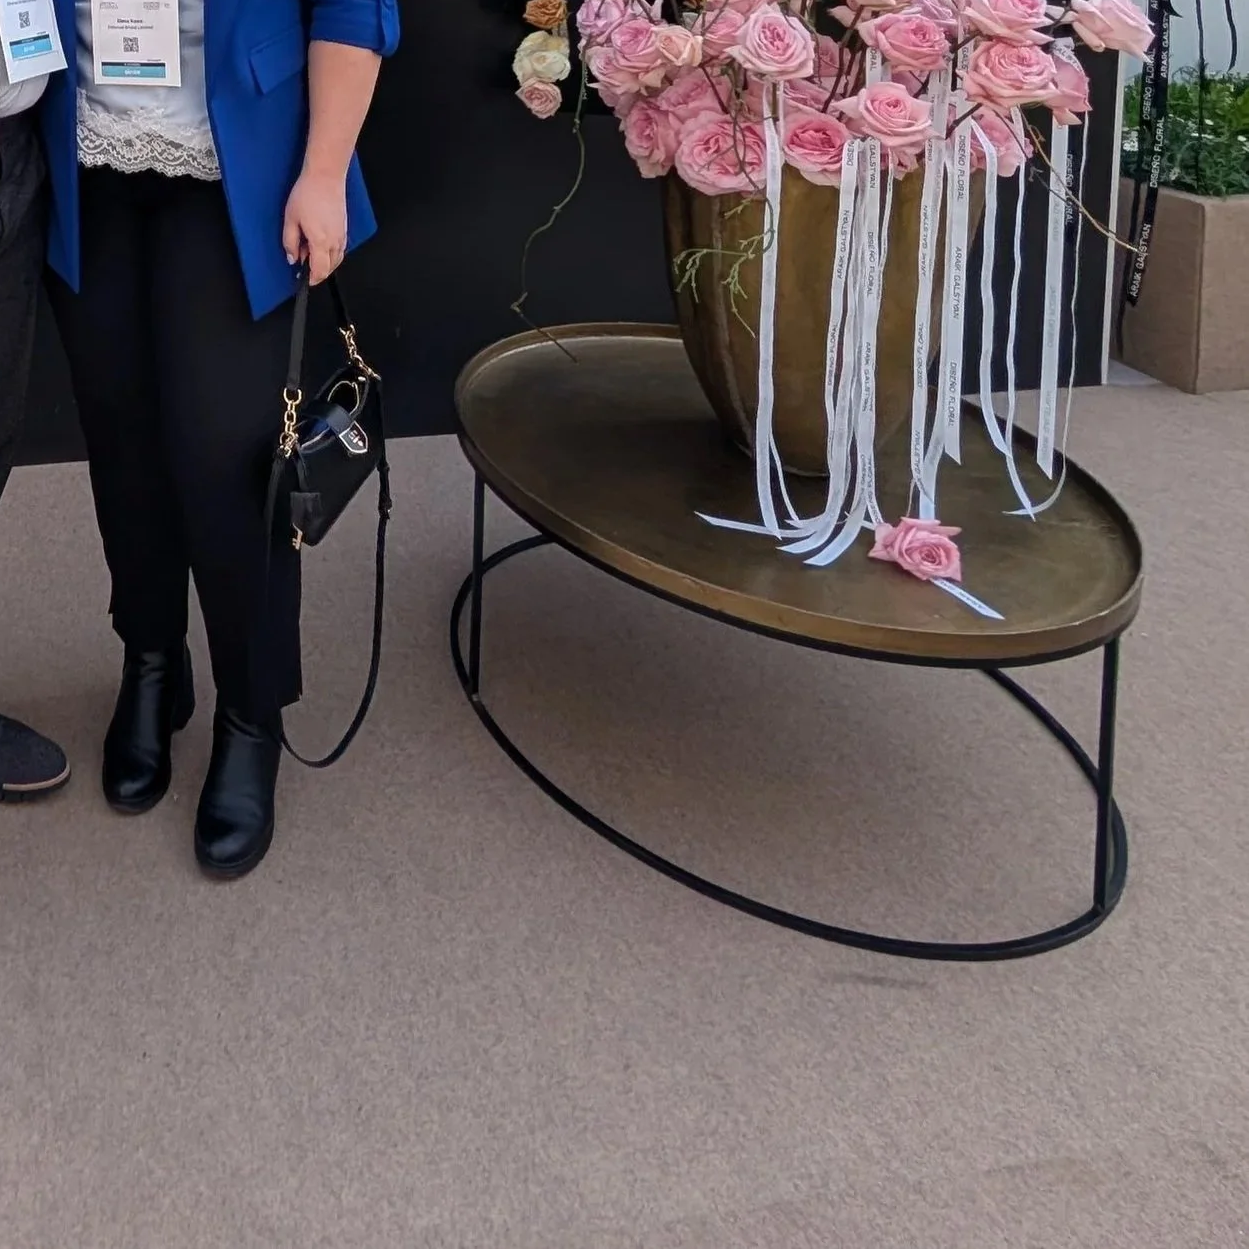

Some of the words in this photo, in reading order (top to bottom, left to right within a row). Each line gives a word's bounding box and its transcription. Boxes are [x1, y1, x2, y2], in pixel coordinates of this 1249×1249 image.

[957, 134, 967, 166] DISEÑO
[1154, 116, 1165, 152] FLORAL
[1150, 155, 1161, 188] DISEÑO
[952, 275, 962, 319] GALSTYAN
[1129, 271, 1140, 298] ARAIK
